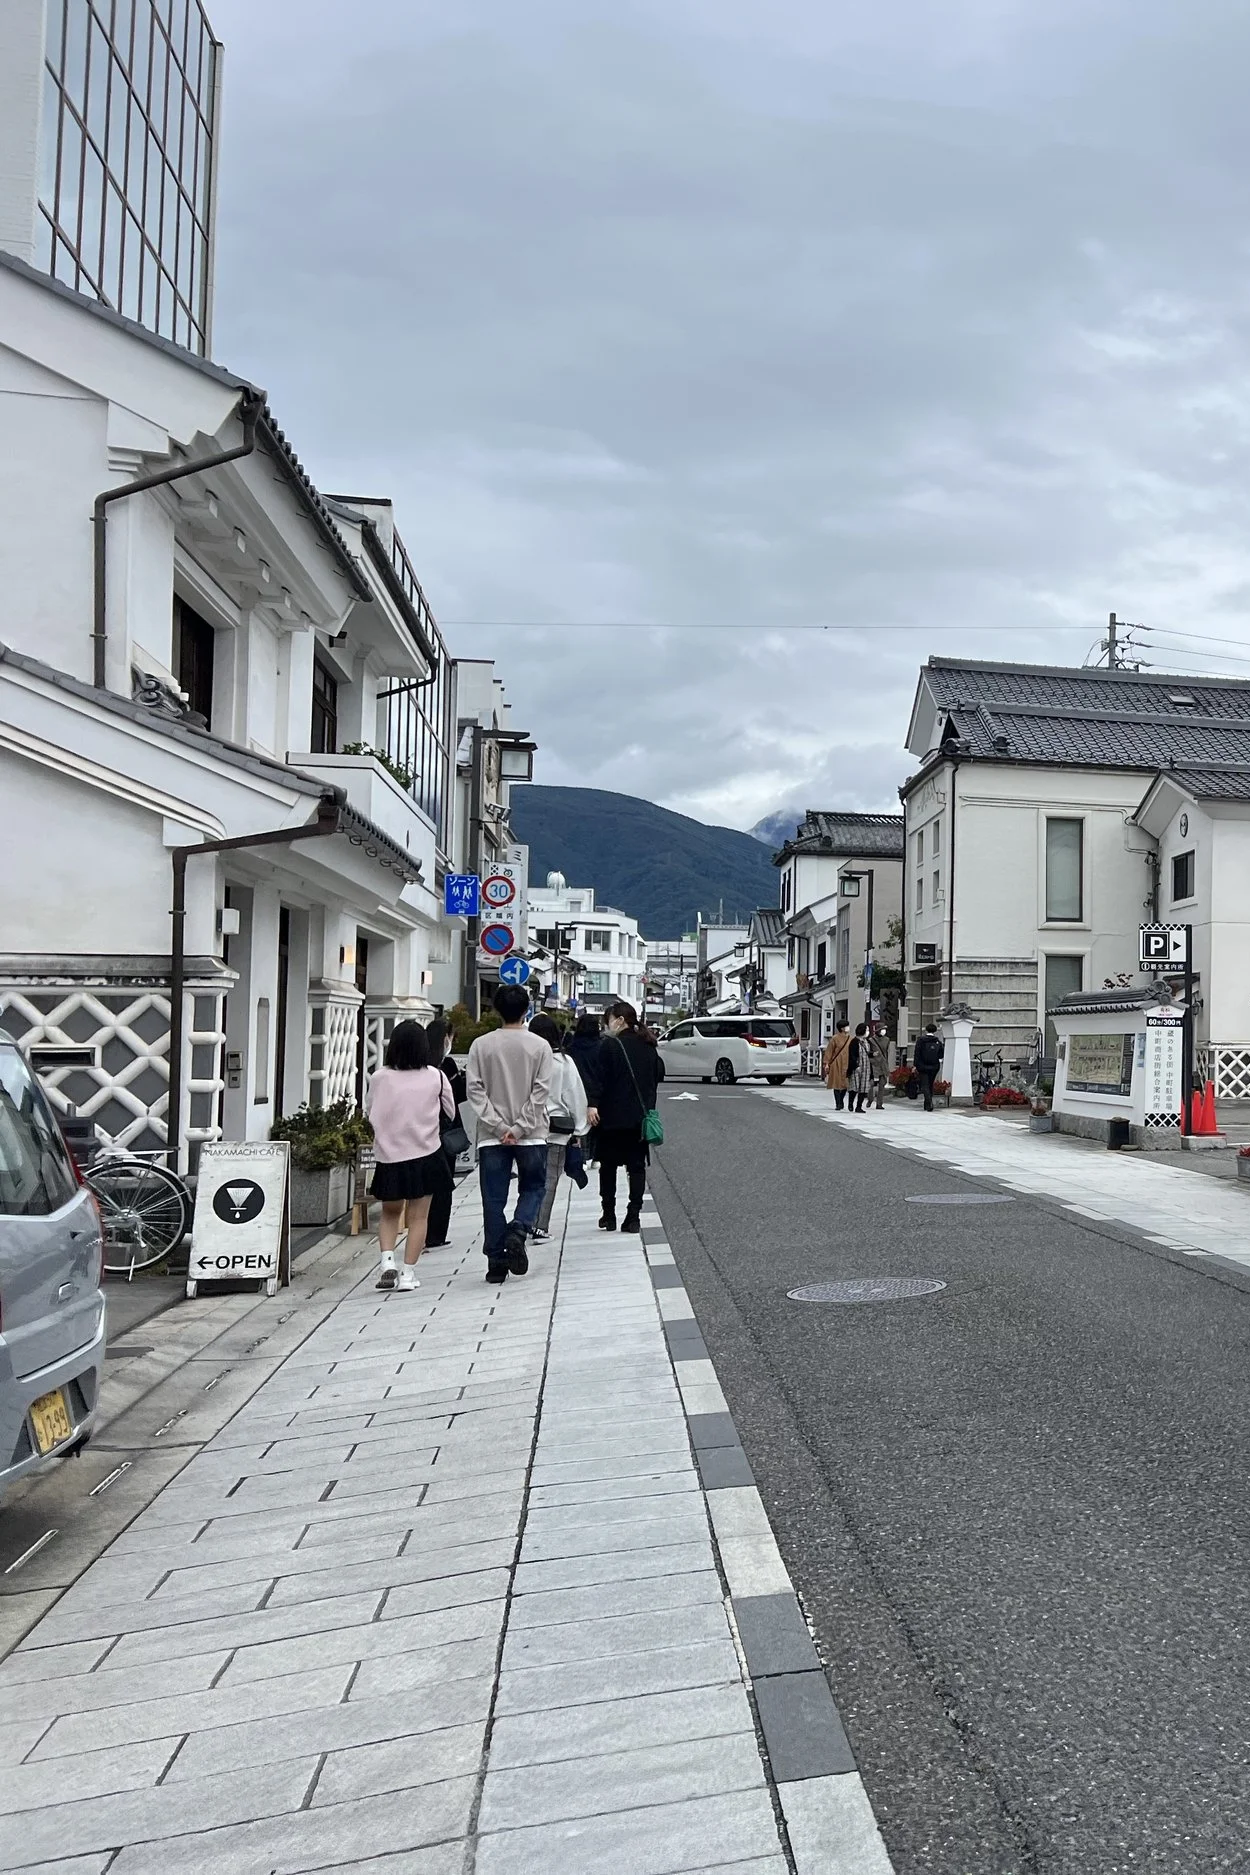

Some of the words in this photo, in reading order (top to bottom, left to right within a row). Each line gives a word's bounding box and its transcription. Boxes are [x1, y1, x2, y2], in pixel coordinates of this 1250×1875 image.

[449, 877, 475, 886] ゾーン
[489, 884, 508, 898] 30
[1150, 937, 1164, 955] P
[259, 1147, 281, 1156] CAFE
[215, 1255, 271, 1269] OPEN
